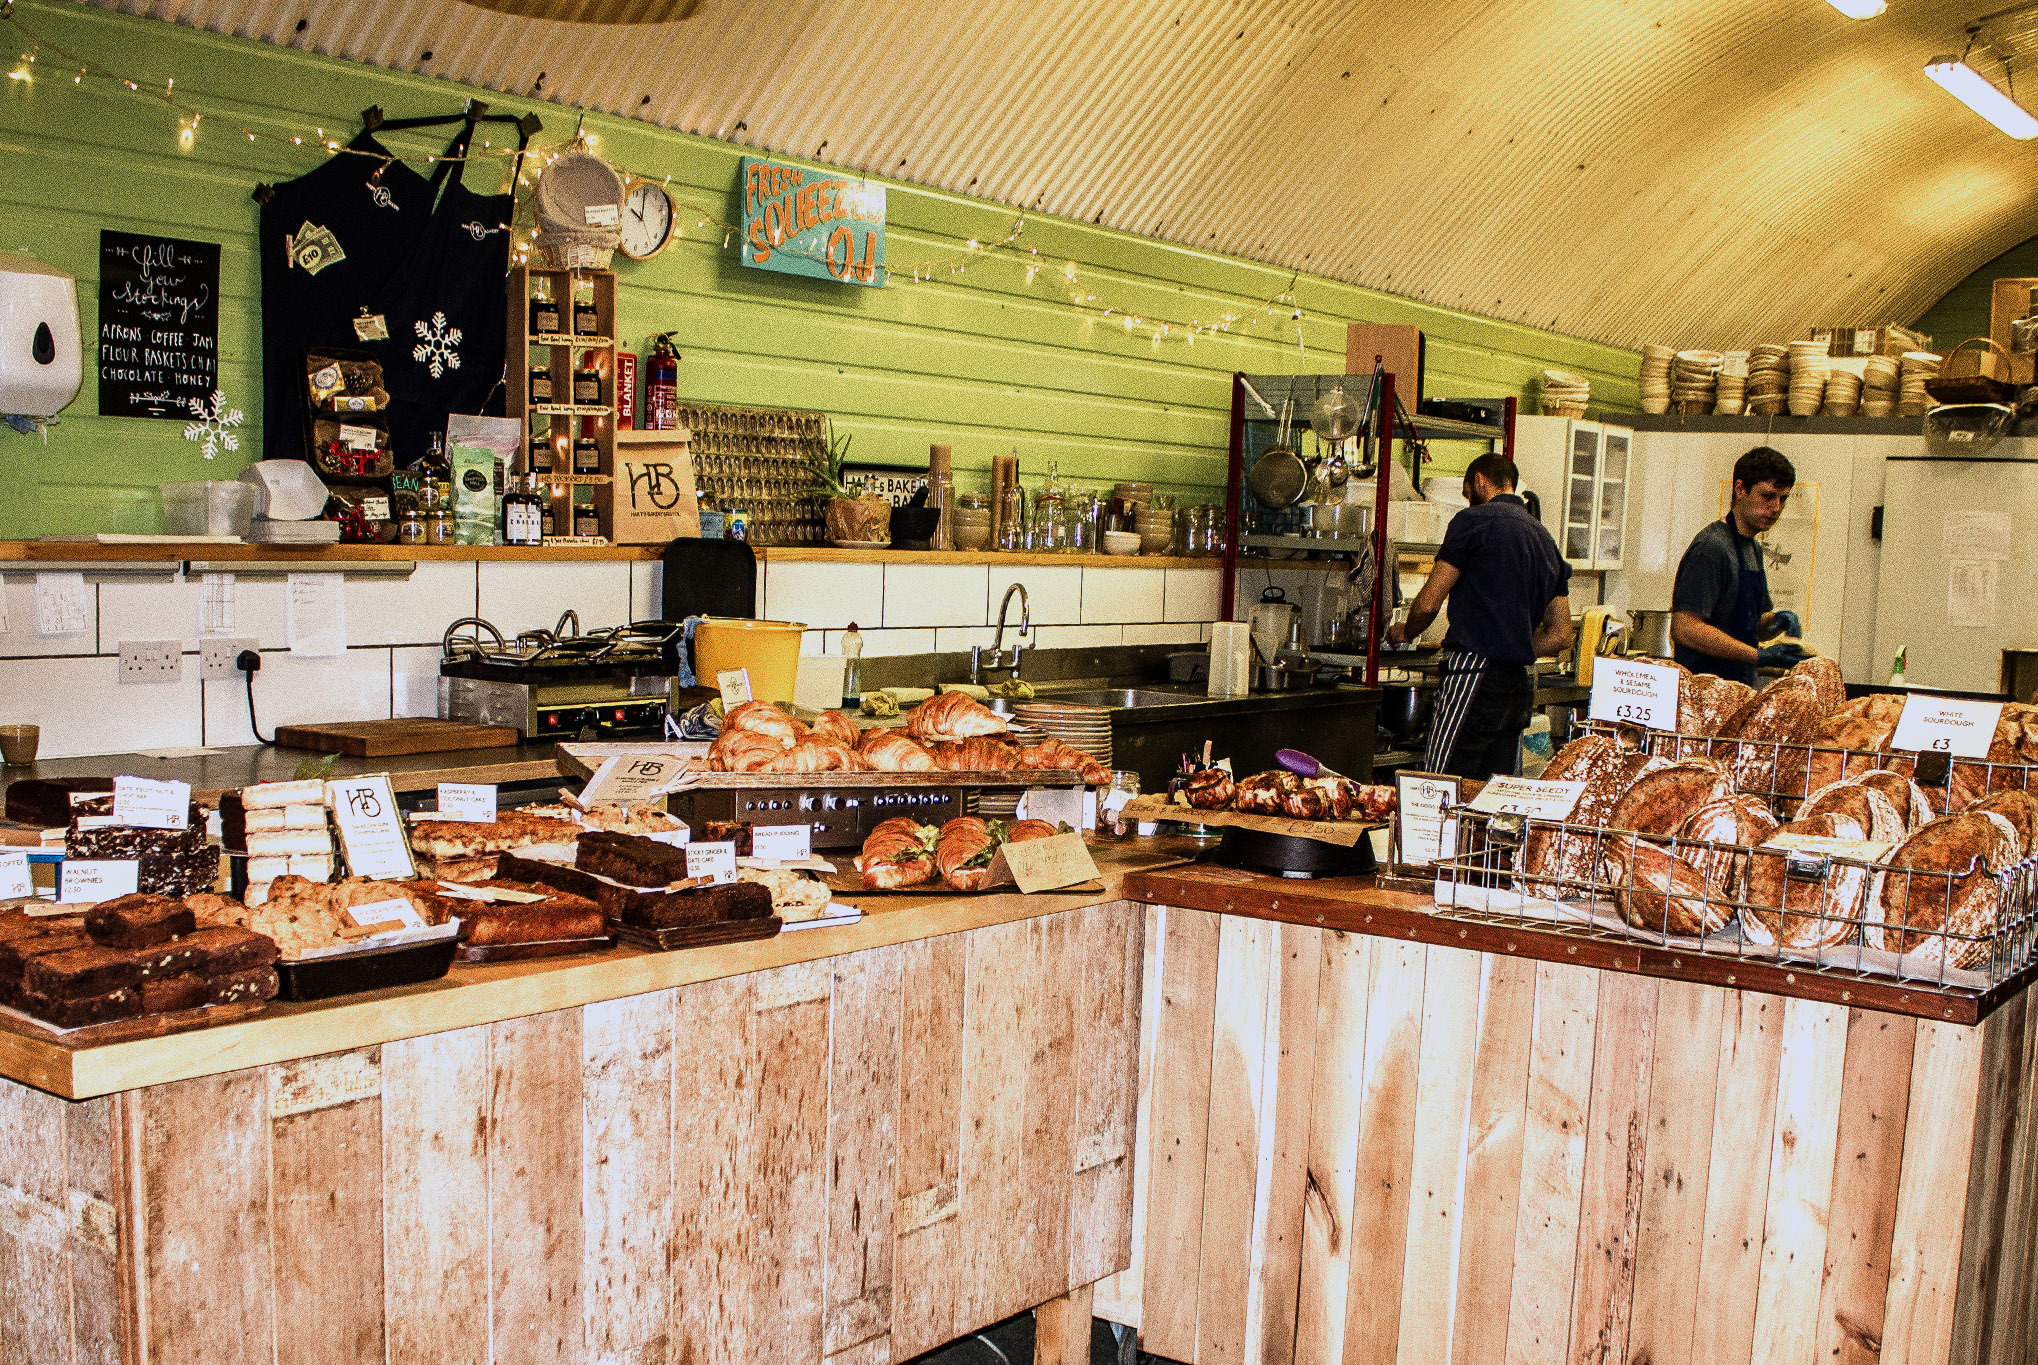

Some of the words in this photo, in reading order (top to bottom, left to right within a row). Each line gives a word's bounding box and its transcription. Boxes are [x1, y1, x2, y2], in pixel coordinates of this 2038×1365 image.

[746, 164, 803, 217] FRESH
[750, 180, 883, 264] SQUEEZ
[303, 250, 319, 265] £10
[102, 323, 142, 342] APRONS
[151, 330, 184, 346] COFFEE
[193, 333, 213, 349] JAM
[103, 344, 139, 363] FLOUR
[145, 348, 187, 369] BASKETS
[102, 366, 164, 383] CHOCOLATE
[175, 372, 211, 387] HONEY
[623, 359, 633, 417] BLANKET
[1615, 670, 1657, 681] WHOLEMEAL
[1626, 679, 1651, 689] SESAME
[1613, 686, 1658, 698] SOURDOUGH
[1617, 705, 1651, 720] £3.25
[1923, 717, 1975, 727] SOURDOUGH
[1933, 738, 1951, 750] £3
[1498, 782, 1532, 792] SUPER
[1536, 786, 1571, 794] SEEDY
